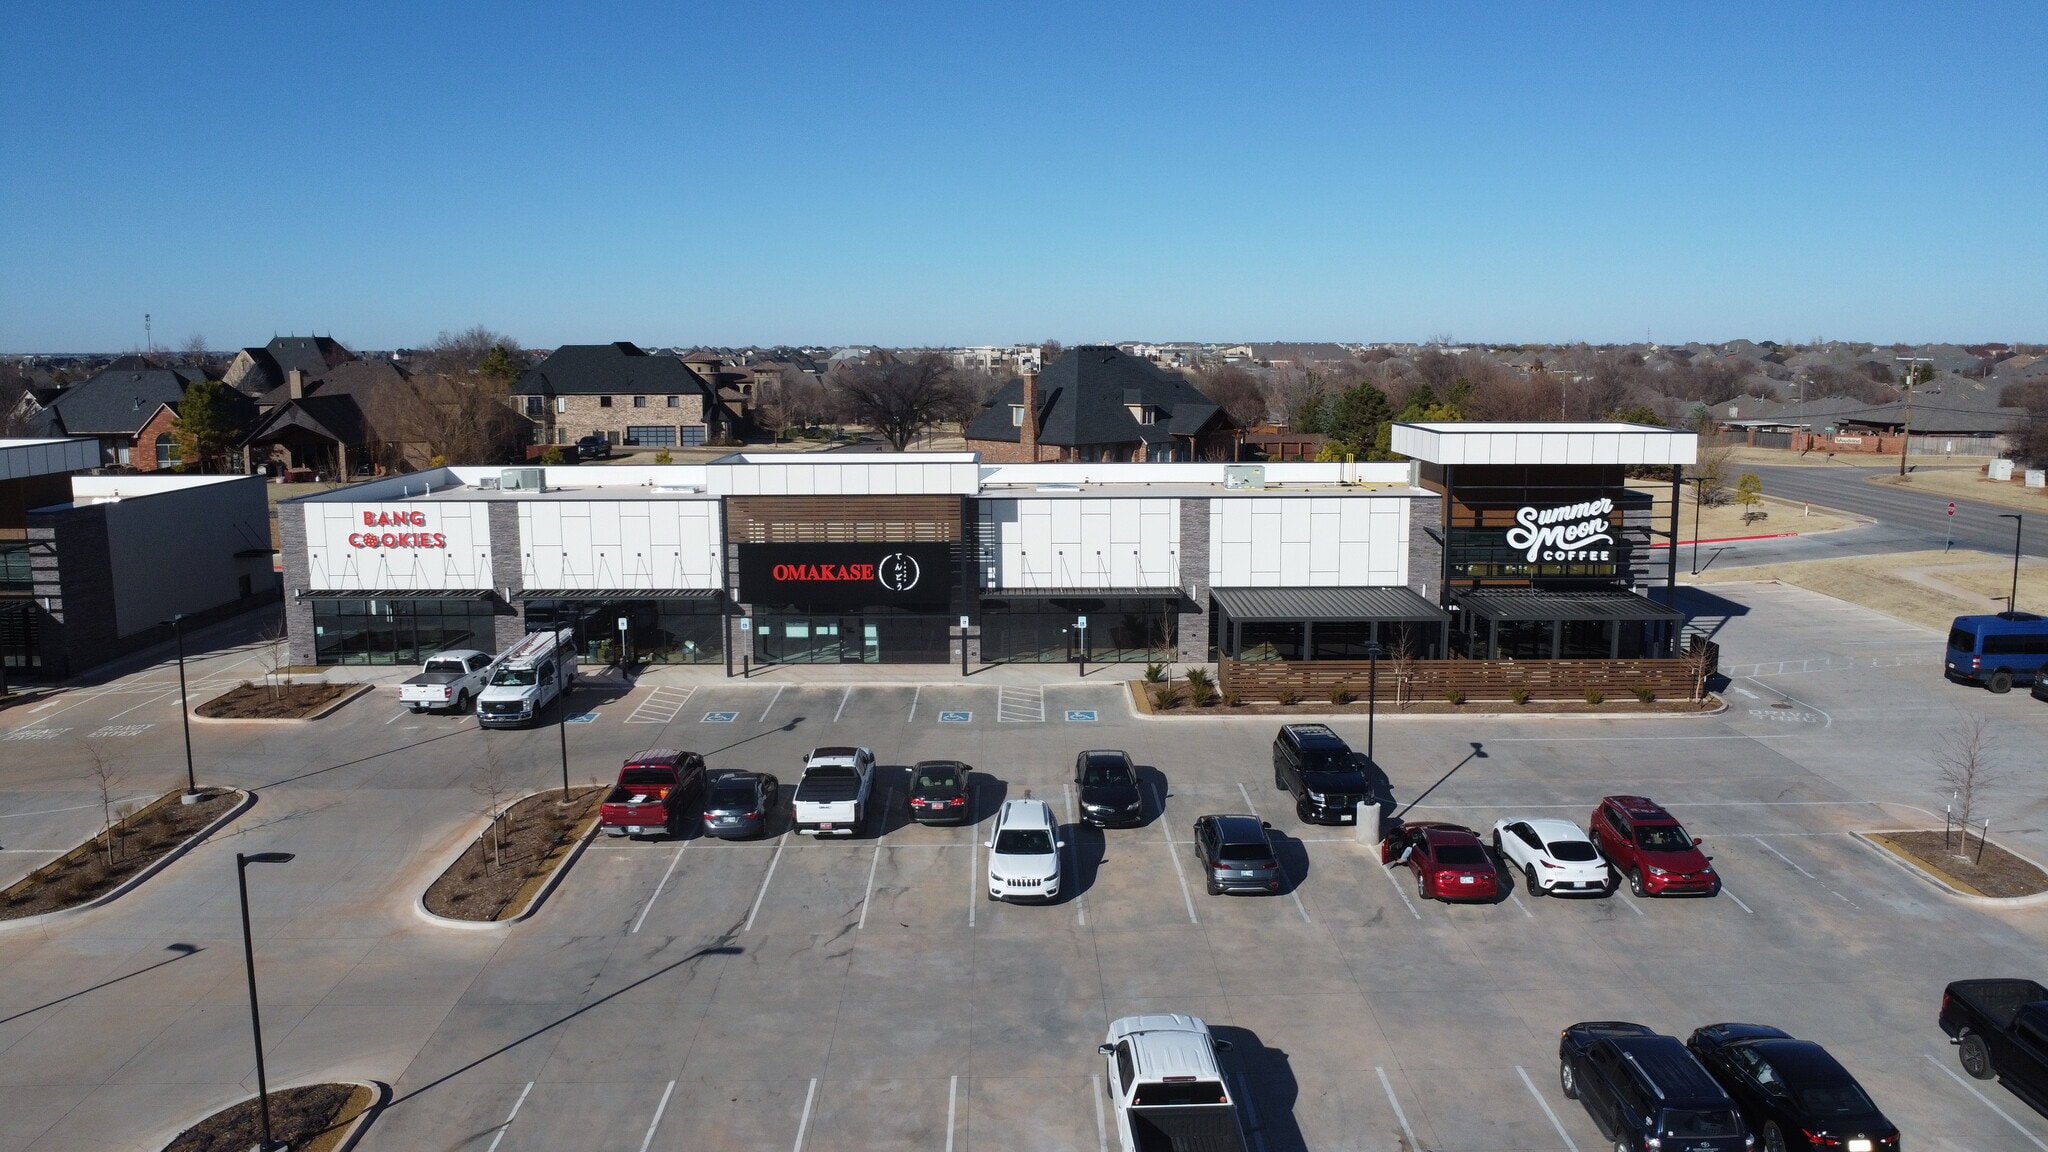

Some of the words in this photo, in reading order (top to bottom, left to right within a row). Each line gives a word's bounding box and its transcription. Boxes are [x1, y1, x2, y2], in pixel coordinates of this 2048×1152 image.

[363, 511, 425, 526] BANG
[1506, 498, 1614, 550] Summer
[1526, 518, 1614, 563] Moon
[1543, 551, 1610, 561] COFFEE
[772, 564, 875, 581] OMAKASE
